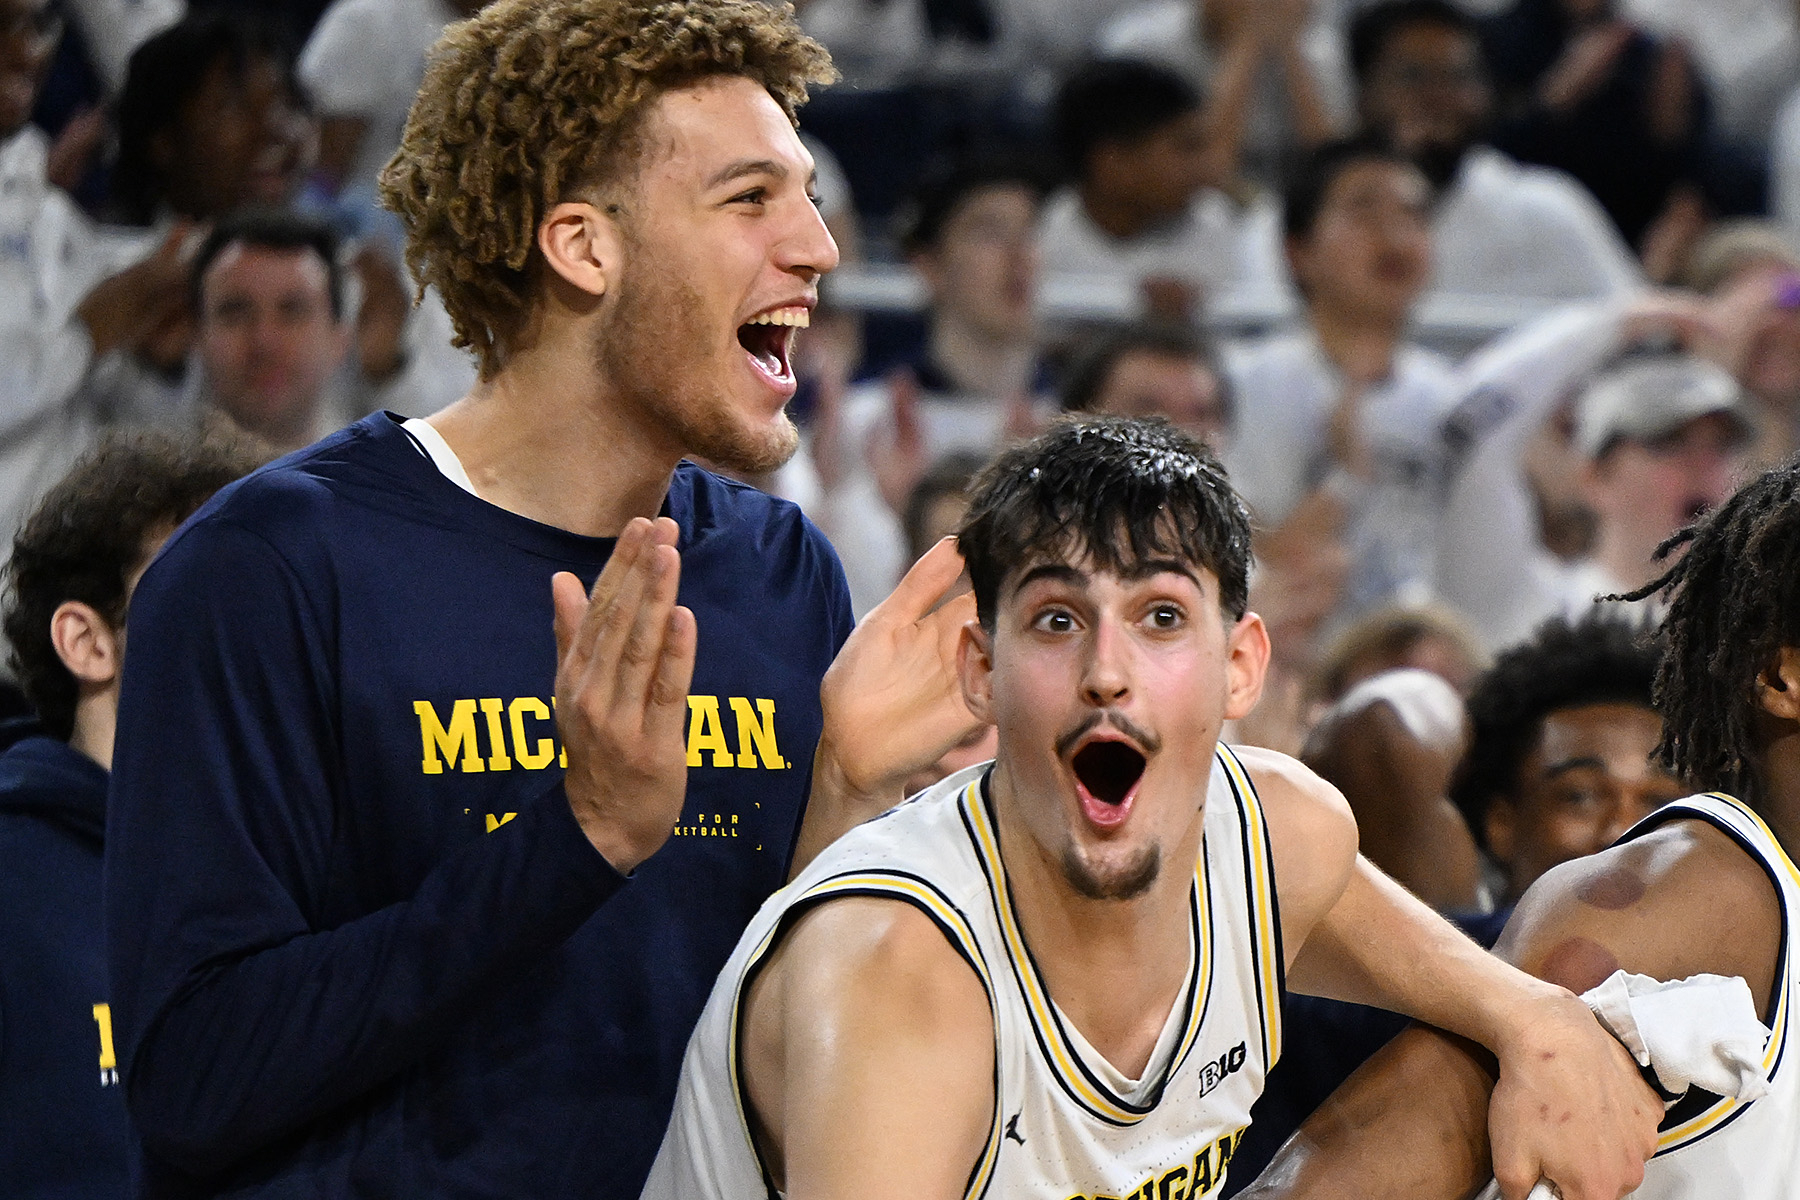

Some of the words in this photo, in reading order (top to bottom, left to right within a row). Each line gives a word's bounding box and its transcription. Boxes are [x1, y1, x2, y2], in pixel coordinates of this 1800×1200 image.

[413, 695, 787, 774] MICAN
[698, 814, 739, 824] FOR
[674, 826, 738, 837] KETBALL
